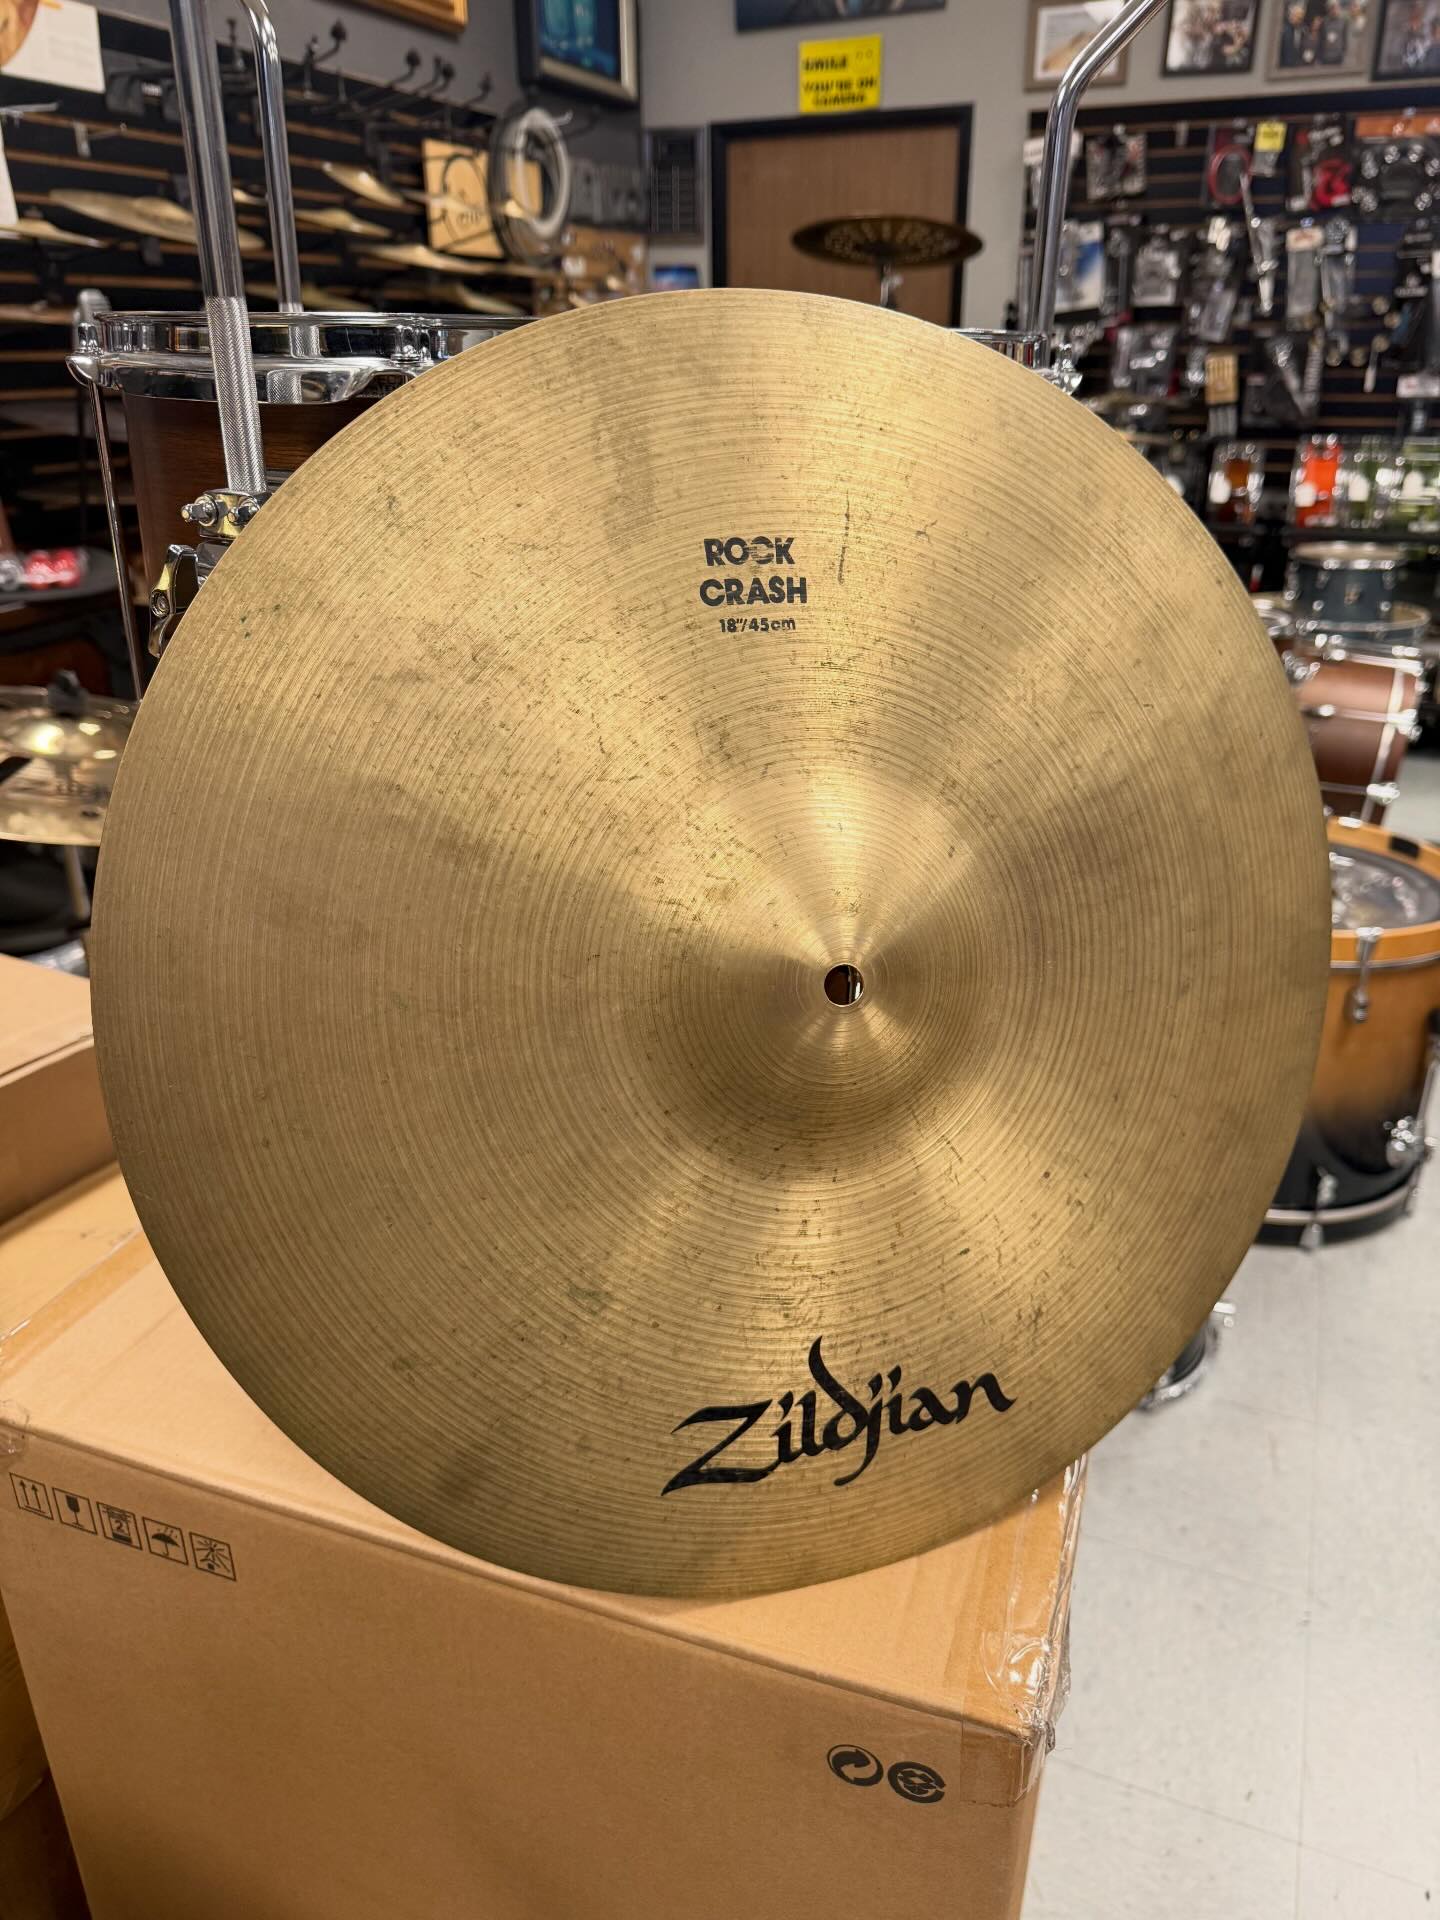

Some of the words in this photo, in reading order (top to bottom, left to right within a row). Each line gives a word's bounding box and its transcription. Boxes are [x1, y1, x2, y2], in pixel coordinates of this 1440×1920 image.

[703, 535, 795, 566] ROCK
[699, 575, 808, 607] CRASH
[660, 1335, 1016, 1497] Zildjian
